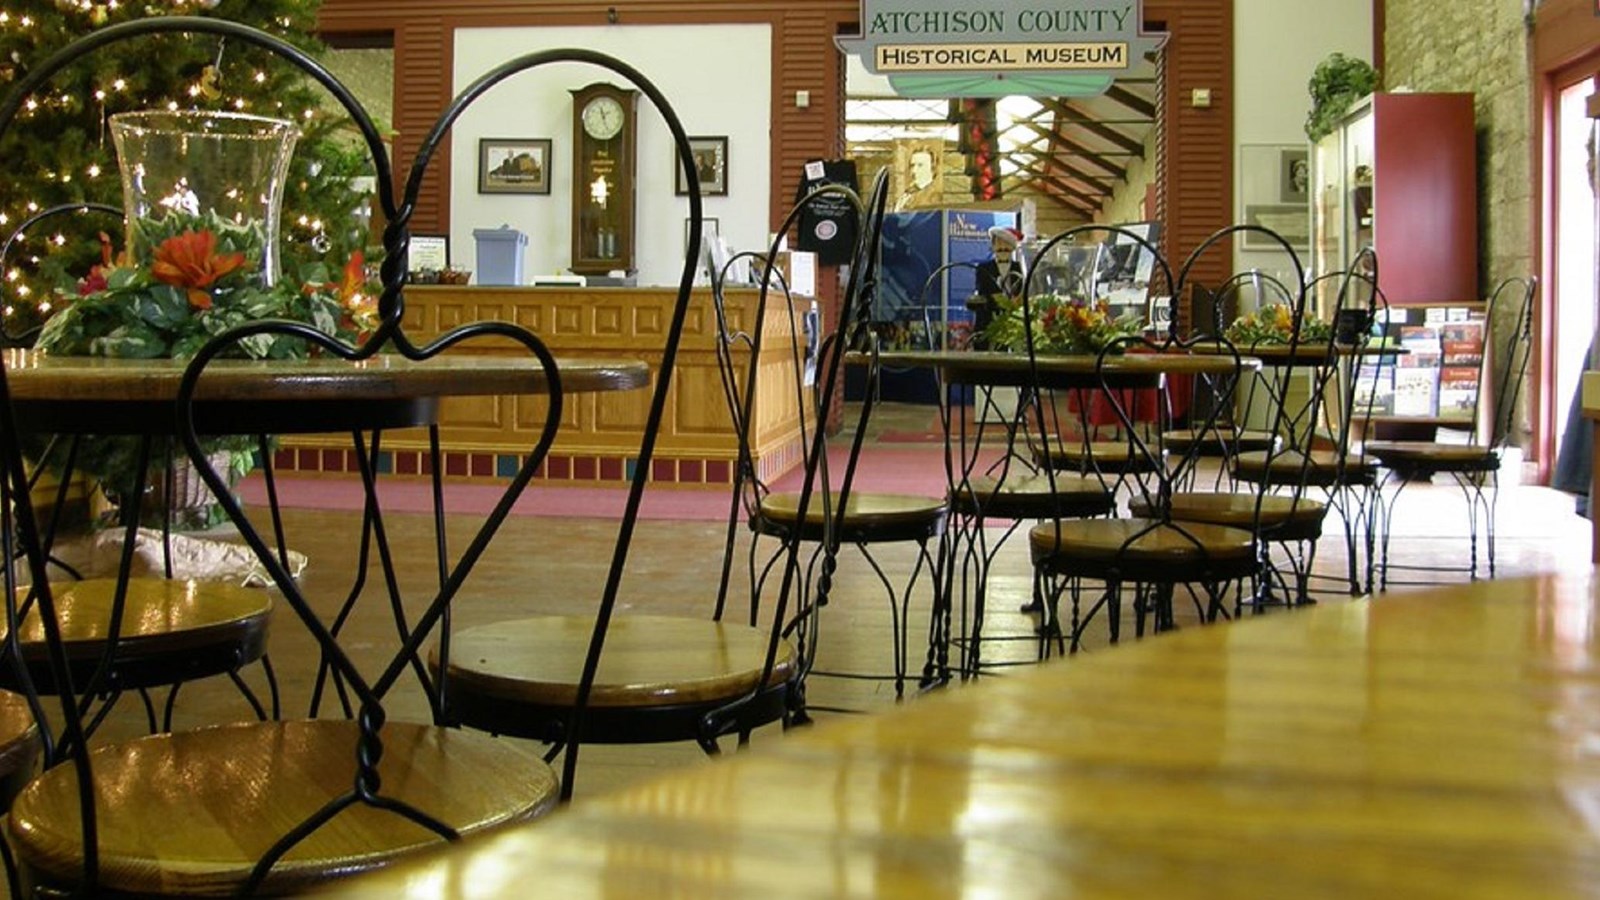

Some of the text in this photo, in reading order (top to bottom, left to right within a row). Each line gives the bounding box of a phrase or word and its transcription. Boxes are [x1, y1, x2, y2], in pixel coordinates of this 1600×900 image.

[870, 5, 1132, 34] ATCHISON COUNTY
[882, 46, 1122, 65] HISTORICAL MUSEUM
